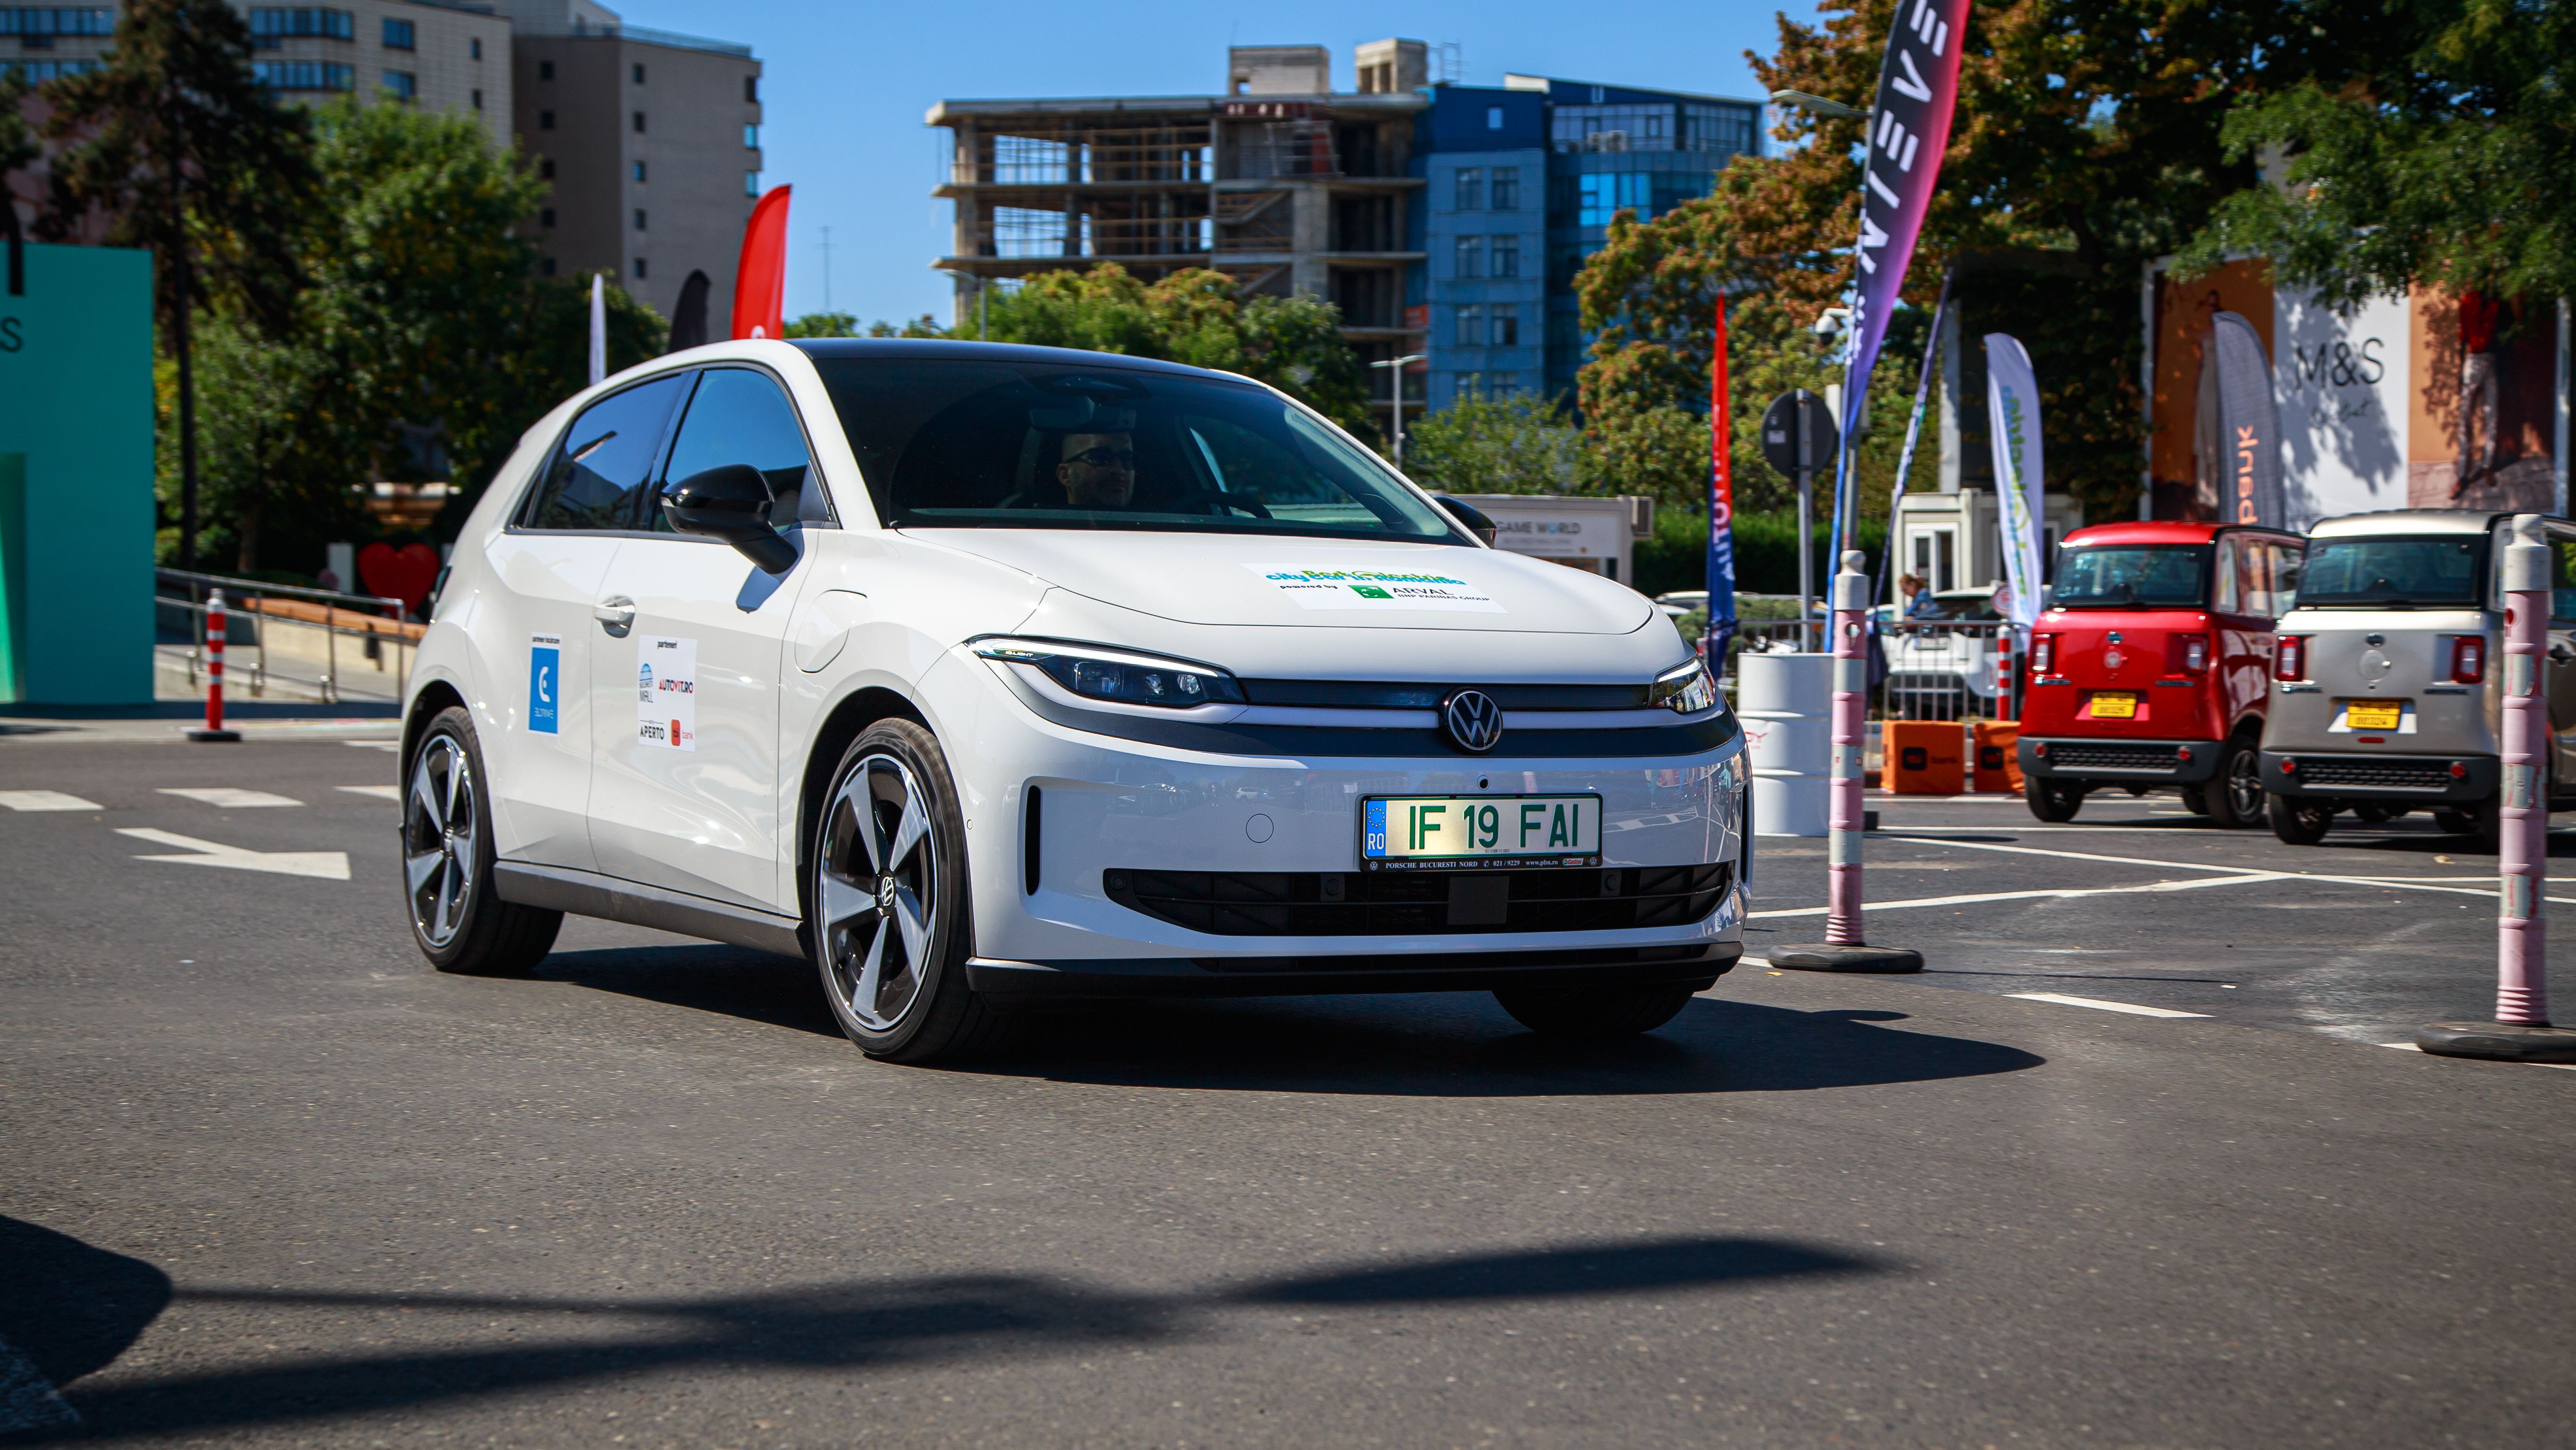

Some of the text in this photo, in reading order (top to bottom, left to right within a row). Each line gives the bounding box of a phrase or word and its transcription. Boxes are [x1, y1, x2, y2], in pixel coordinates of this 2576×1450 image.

[2296, 337, 2384, 390] M&S
[1266, 573, 1310, 582] city
[659, 679, 693, 693] AUTOVIT.RO
[640, 725, 664, 740] APERTO
[1409, 804, 1578, 850] IF 19 FAI
[1368, 833, 1385, 850] RO
